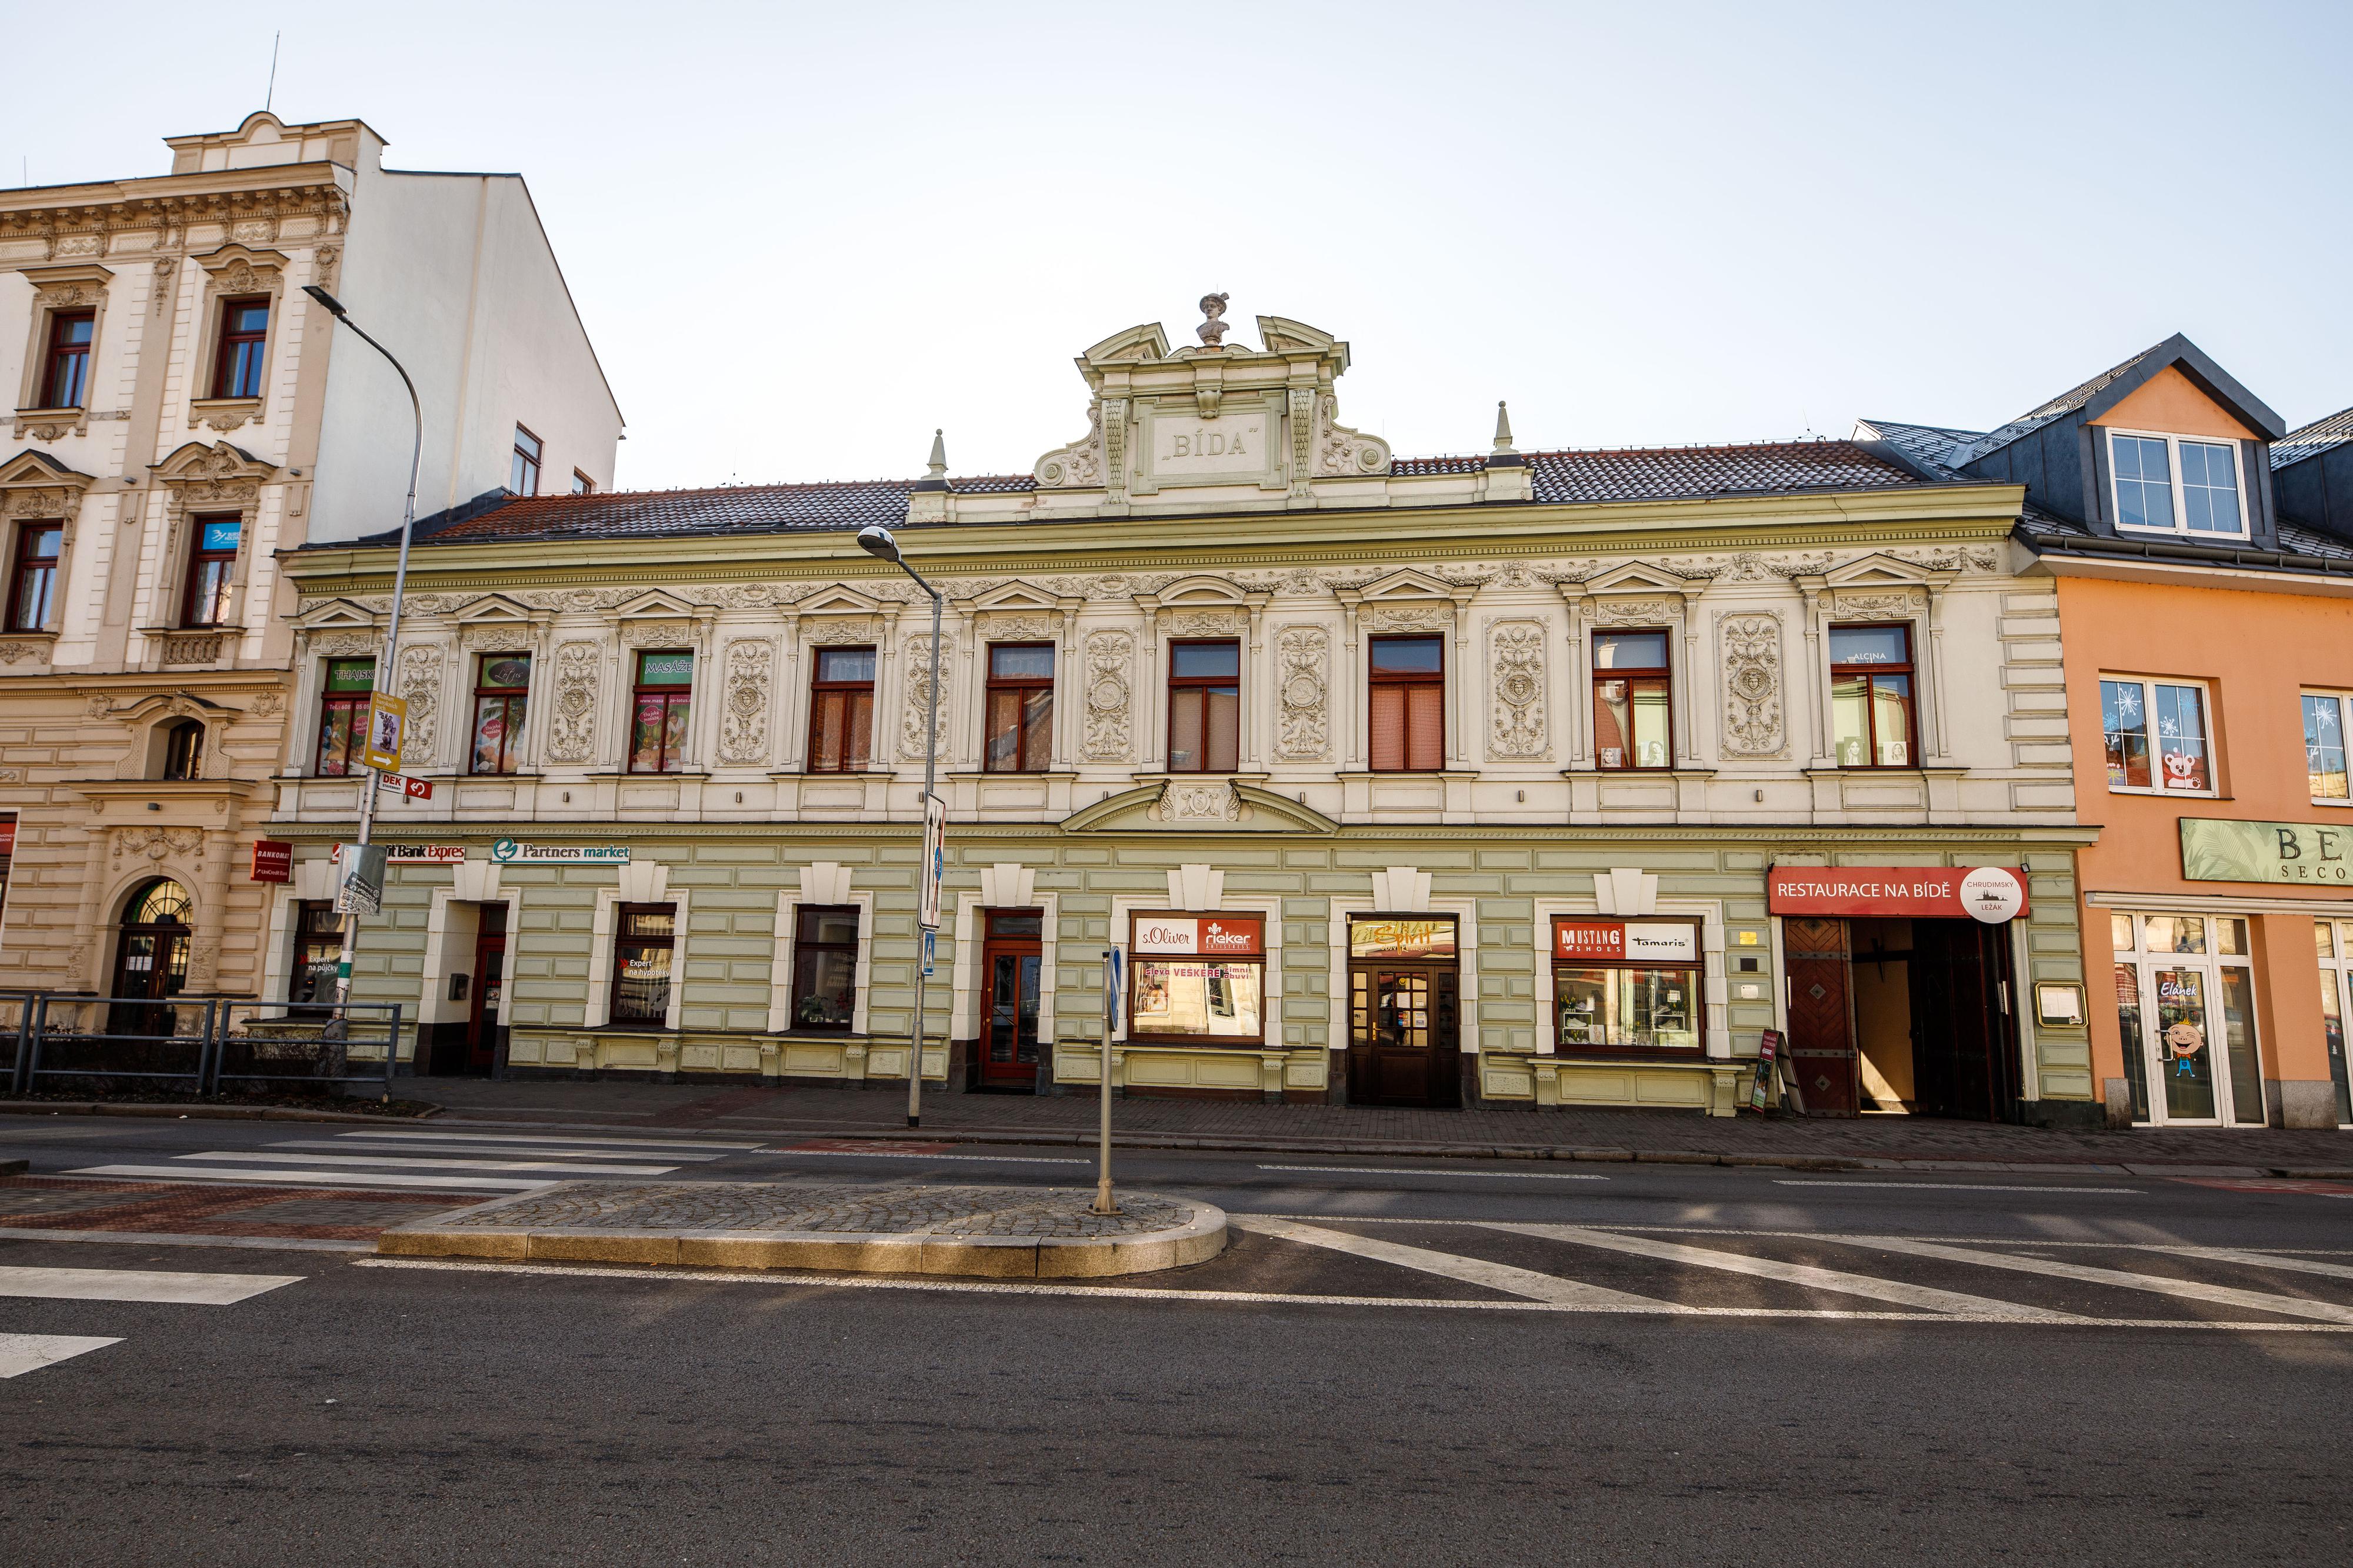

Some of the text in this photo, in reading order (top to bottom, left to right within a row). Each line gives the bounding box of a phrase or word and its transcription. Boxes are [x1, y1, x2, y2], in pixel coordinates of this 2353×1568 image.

[645, 659, 692, 673] MASÁŽE
[335, 669, 375, 680] THAJSK
[383, 775, 402, 786] DEK
[257, 850, 290, 859] BANKOMAT
[398, 845, 426, 858] Bank
[428, 845, 465, 860] Expres
[522, 845, 629, 858] Partners market
[1778, 881, 1951, 898] RESTAURACE NA BÍDĚ
[1967, 880, 2014, 888] CHRUDIMSKÝ
[1981, 903, 2003, 911] LEŽÁK
[1142, 926, 1190, 945] s.Oliver
[1206, 932, 1251, 944] rieker
[1374, 923, 1431, 956] Spirit
[1562, 930, 1620, 945] MUSTANG
[309, 956, 330, 964] Expert
[629, 959, 652, 968] Expert
[318, 963, 338, 972] půjčky
[639, 968, 670, 978] hypotéky
[1146, 967, 1220, 978] sleva VEŠKERÉ
[2161, 982, 2197, 996] Elánek
